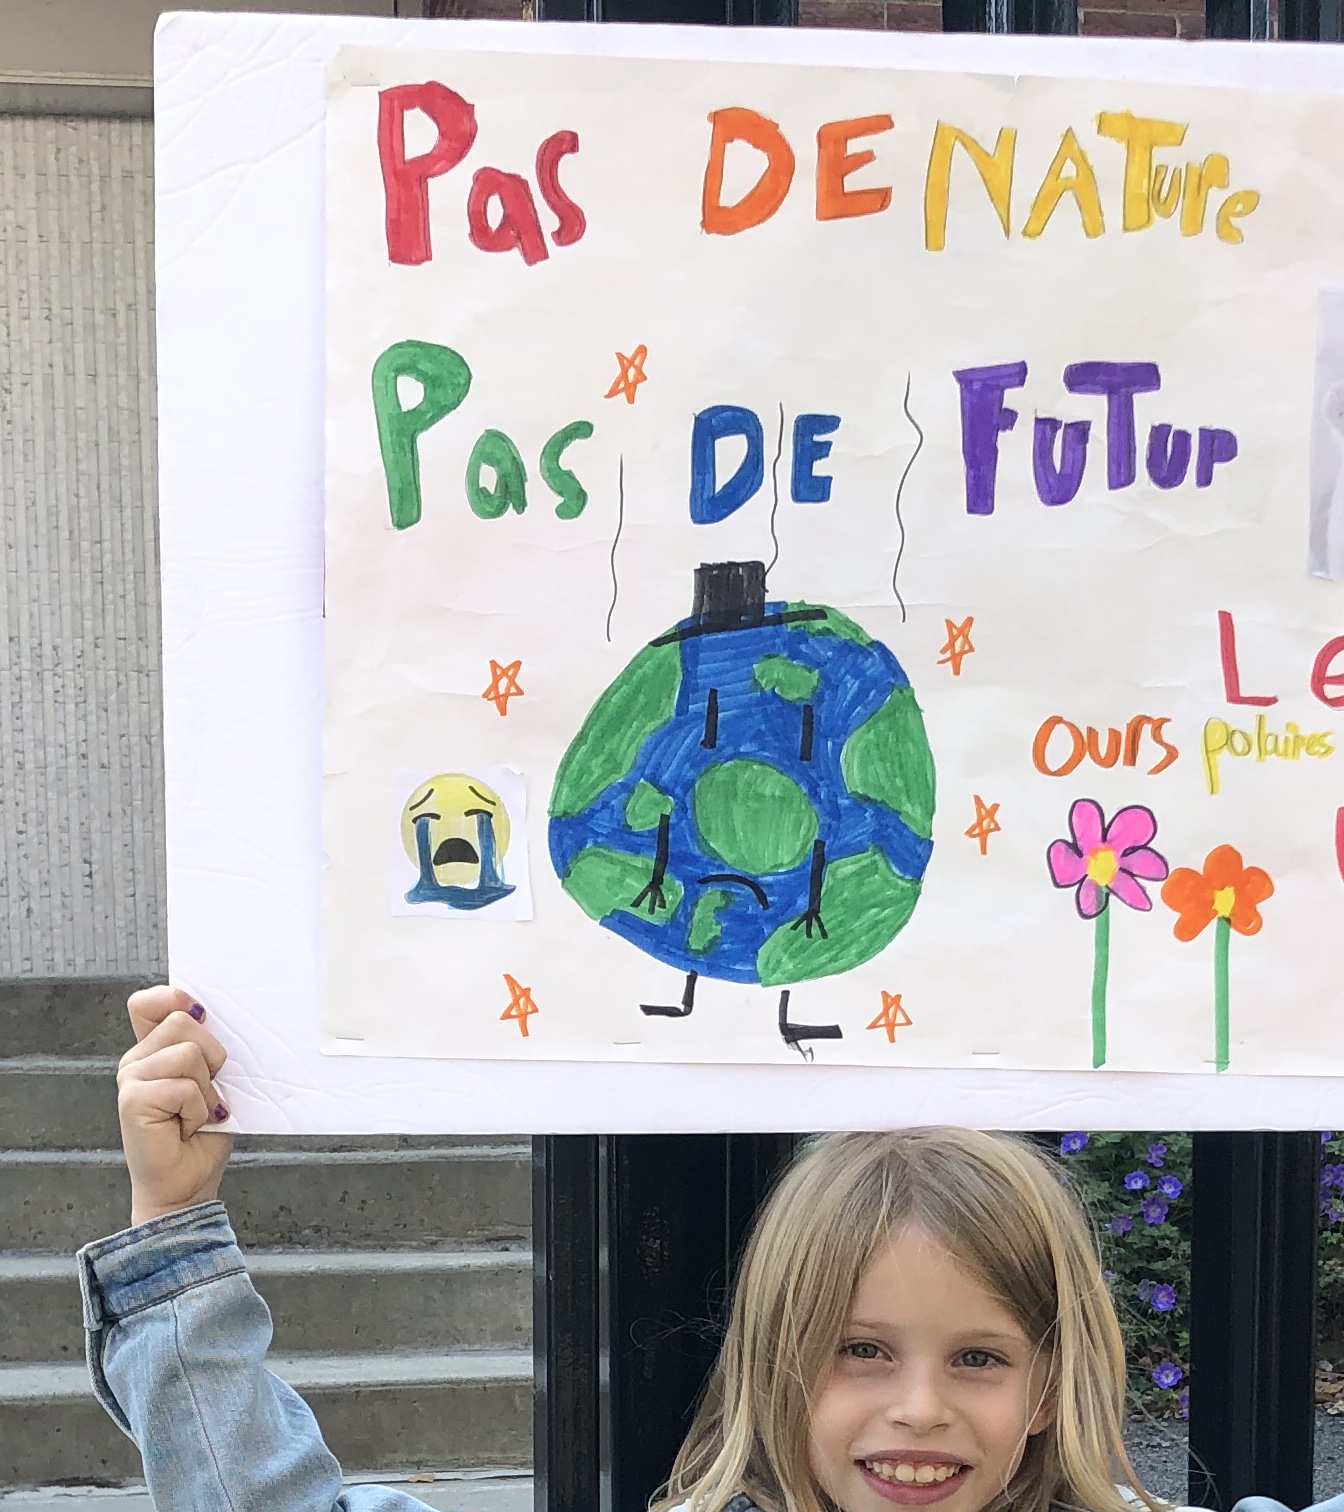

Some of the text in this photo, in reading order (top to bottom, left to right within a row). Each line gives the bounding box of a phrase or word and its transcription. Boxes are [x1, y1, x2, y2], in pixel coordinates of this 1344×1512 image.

[377, 81, 586, 266] Pas
[700, 107, 894, 236] DE
[372, 339, 594, 530] Pas
[690, 404, 841, 524] DE
